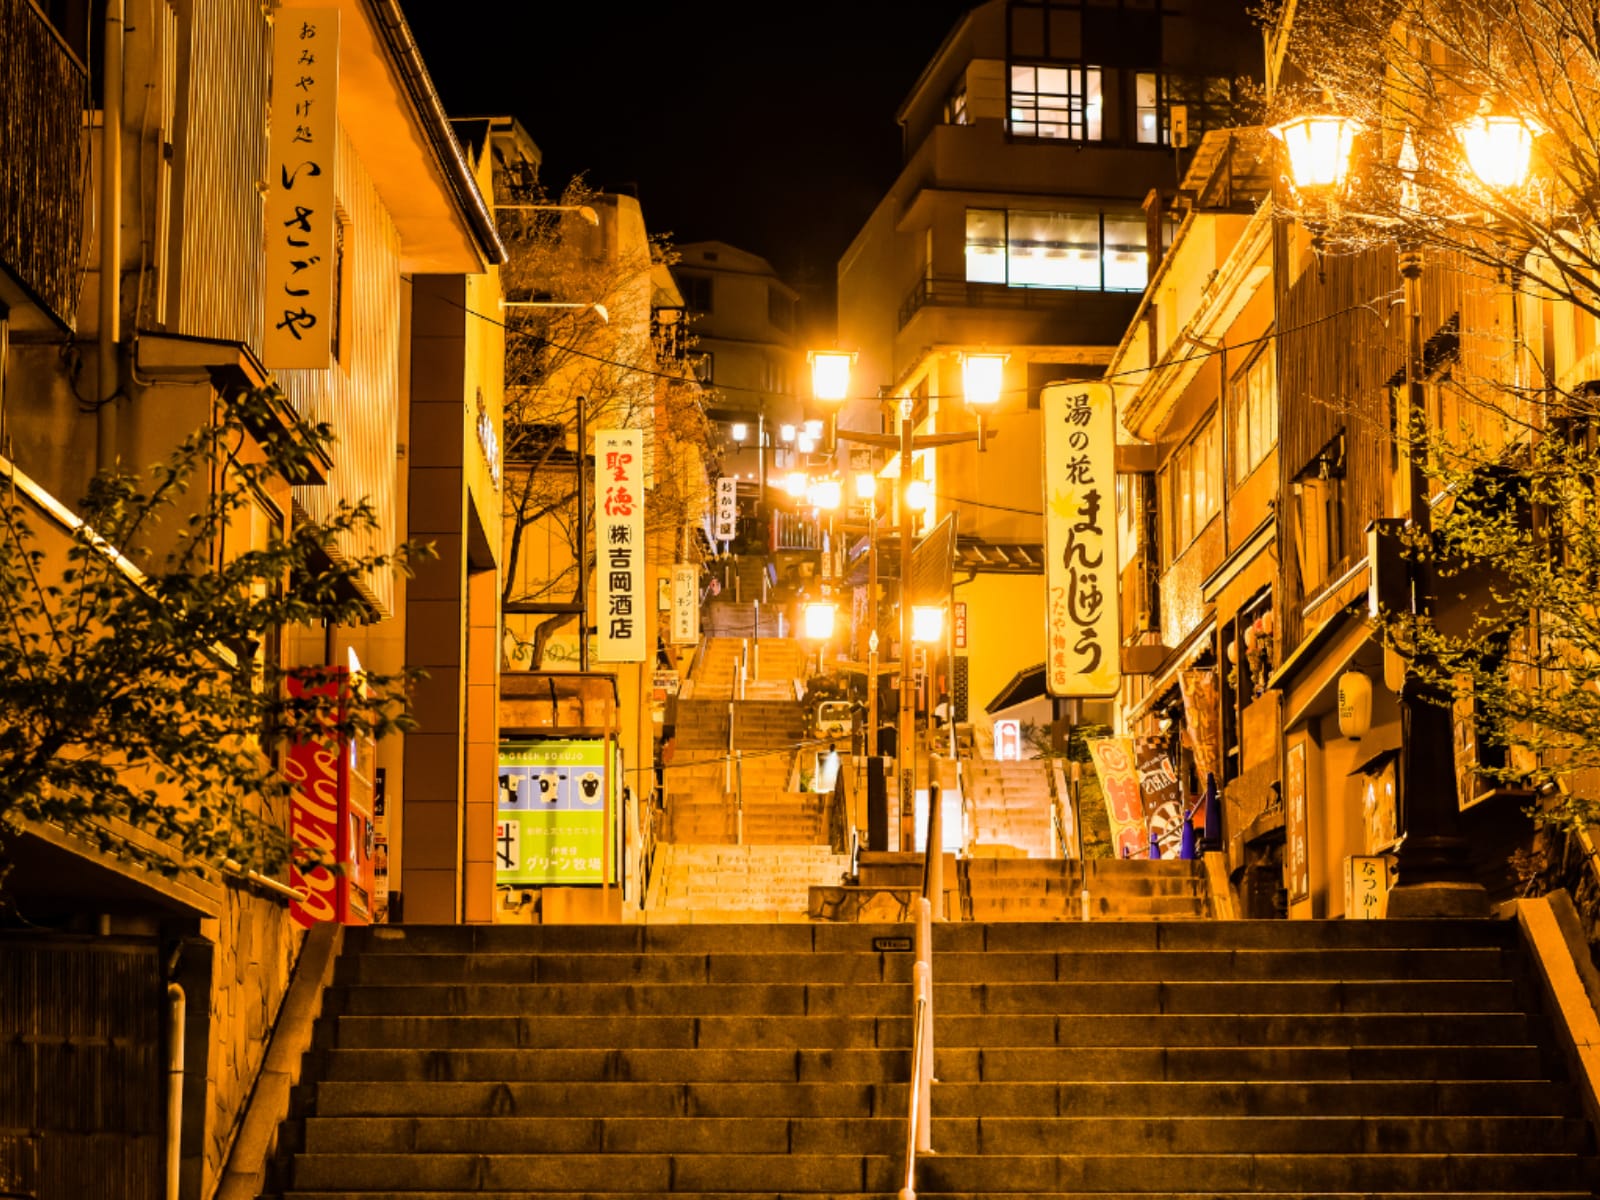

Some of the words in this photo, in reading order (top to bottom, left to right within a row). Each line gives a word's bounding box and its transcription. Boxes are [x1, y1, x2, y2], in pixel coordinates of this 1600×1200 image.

[292, 21, 317, 144] おみやげ処
[275, 160, 322, 341] いさごや
[1064, 392, 1095, 485] 湯の花
[1050, 585, 1067, 686] つたや物産店
[1063, 488, 1104, 674] まんじゅう
[526, 857, 601, 872] グリーン牧場
